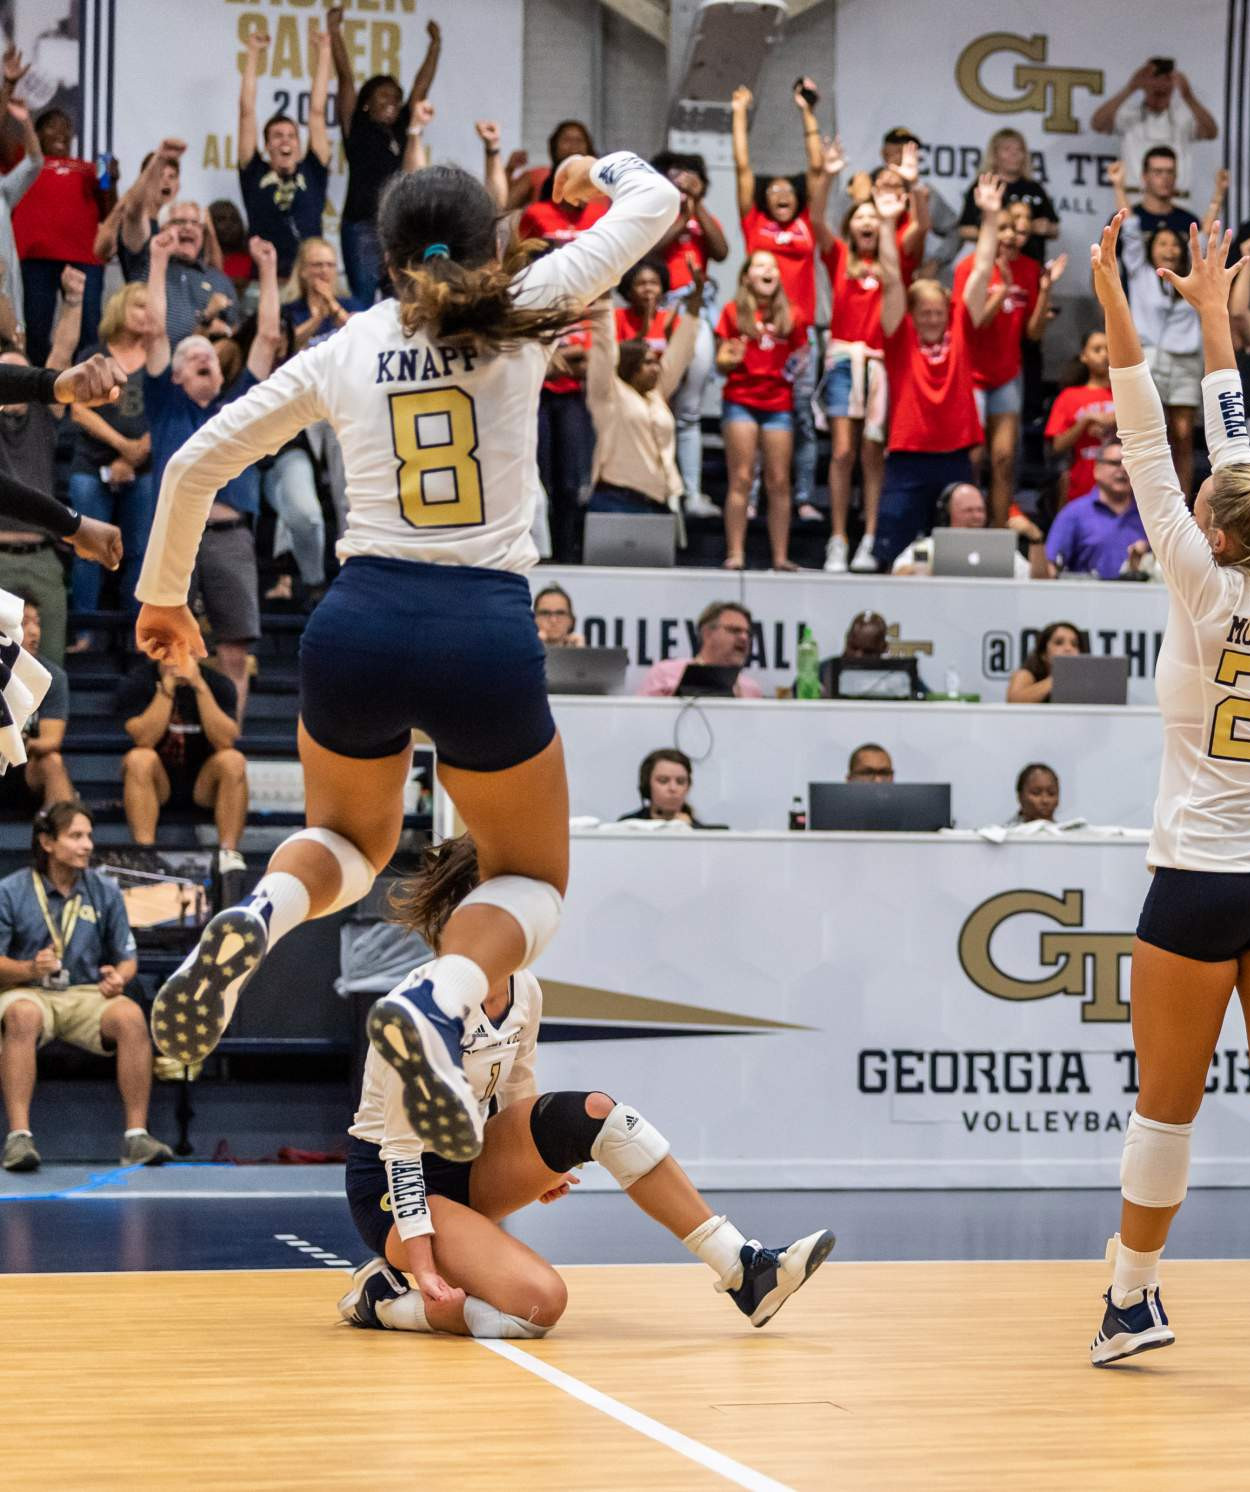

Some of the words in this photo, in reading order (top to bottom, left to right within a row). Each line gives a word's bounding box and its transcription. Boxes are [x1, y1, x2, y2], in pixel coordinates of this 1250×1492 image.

[955, 31, 1104, 133] GT
[376, 346, 478, 384] KNAPP
[387, 386, 486, 529] 8
[858, 1049, 1091, 1094] GEORGIA
[962, 1110, 1132, 1133] VOLLEYBA
[391, 1160, 427, 1219] JACKETS
